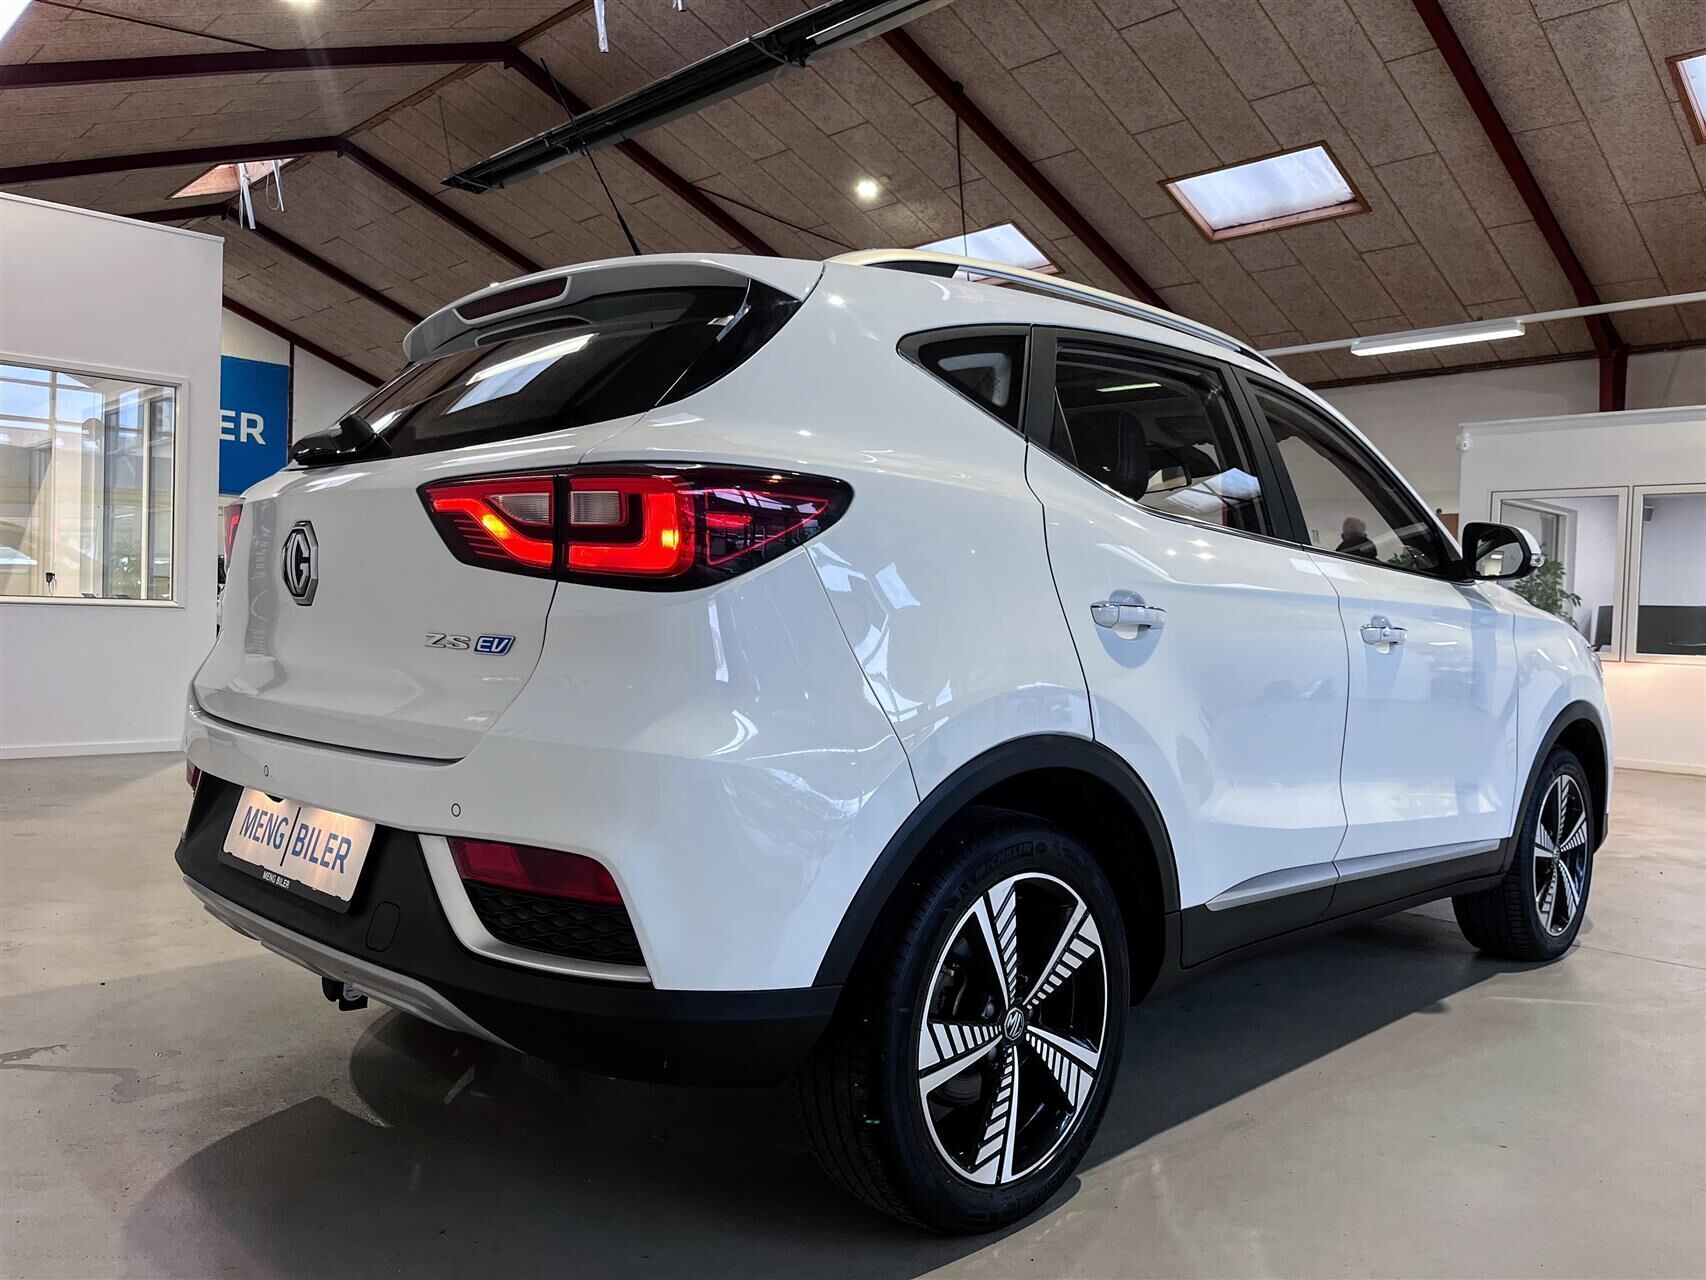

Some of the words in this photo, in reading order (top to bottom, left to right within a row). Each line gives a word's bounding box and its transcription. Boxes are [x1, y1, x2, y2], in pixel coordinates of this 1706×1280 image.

[424, 632, 471, 650] ZS
[476, 636, 512, 653] EV
[239, 805, 289, 850] MENG
[291, 823, 353, 874] BILER
[975, 840, 1034, 880] MICHELIN
